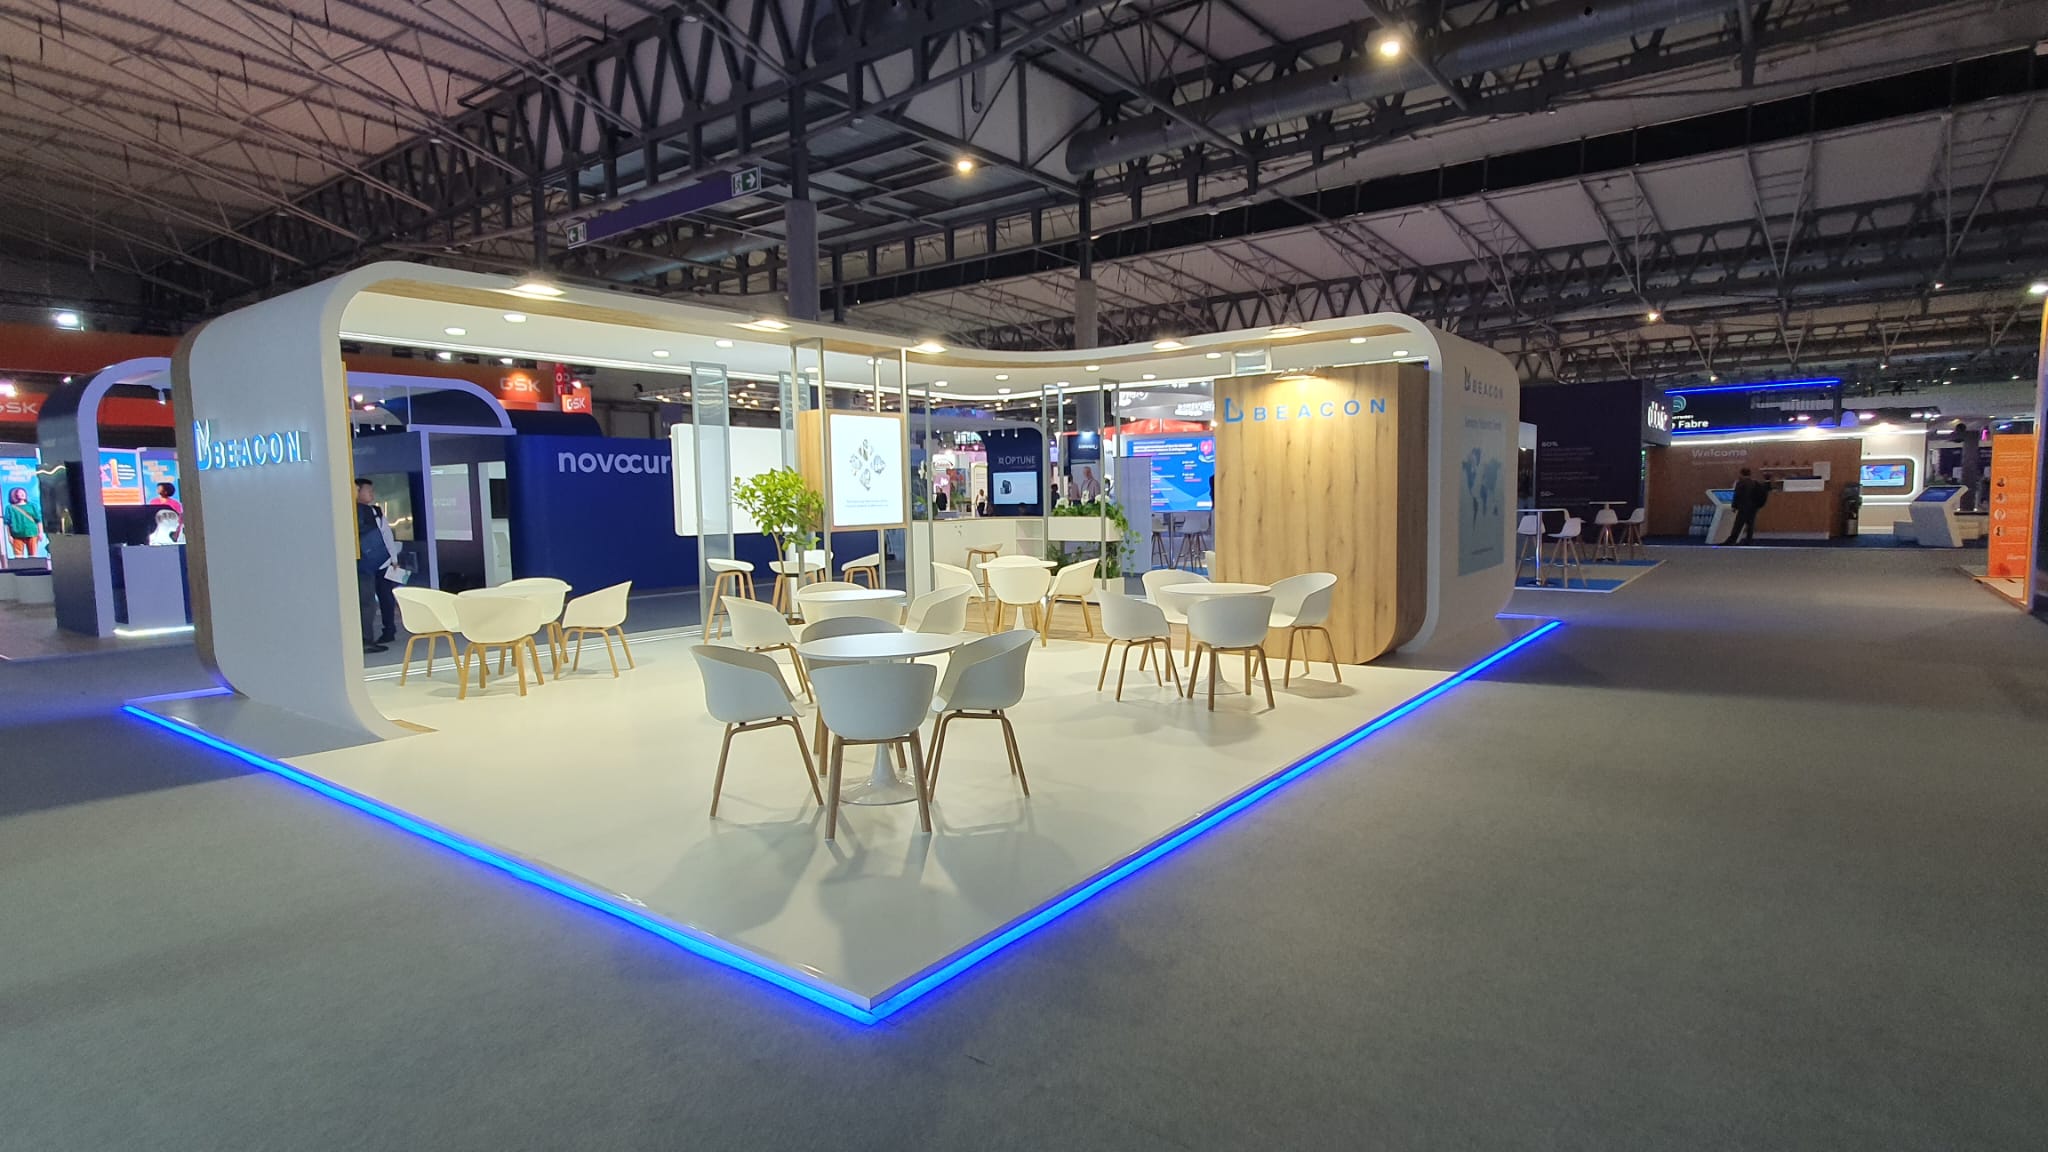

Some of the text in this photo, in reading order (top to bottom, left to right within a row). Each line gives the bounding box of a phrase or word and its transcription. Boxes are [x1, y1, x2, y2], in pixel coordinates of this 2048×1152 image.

[500, 375, 541, 393] GSK
[1472, 378, 1504, 401] BEACON
[566, 397, 587, 410] GSK
[1253, 398, 1386, 422] BEACON
[1678, 419, 1710, 430] Fabre
[213, 430, 302, 469] BEACON
[1692, 448, 1749, 457] Welcome
[558, 452, 671, 474] novocur
[1005, 455, 1037, 465] OPTUNE
